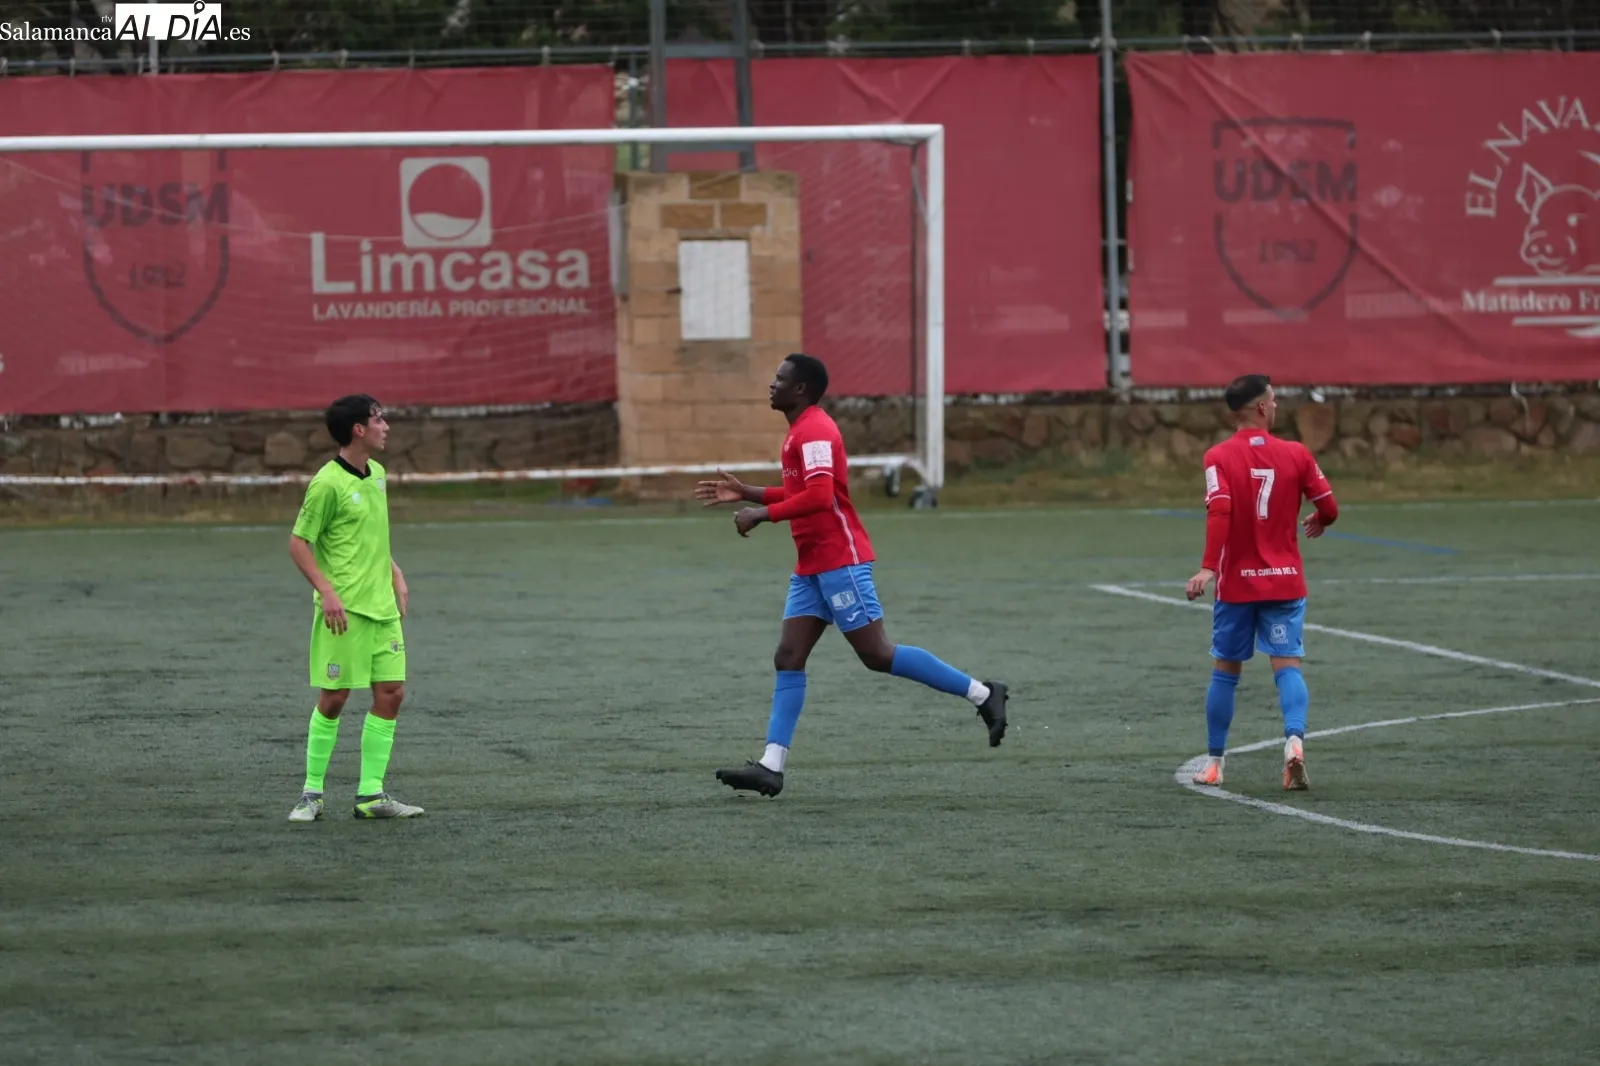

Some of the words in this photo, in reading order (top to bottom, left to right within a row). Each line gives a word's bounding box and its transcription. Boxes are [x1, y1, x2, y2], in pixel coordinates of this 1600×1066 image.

[1482, 94, 1600, 165] NAVA
[82, 182, 229, 228] UDSM
[1465, 163, 1503, 218] EL
[310, 231, 591, 294] Limcasa
[312, 297, 444, 321] LAVANDERÍA
[448, 296, 590, 319] PROFESIONAL
[1461, 288, 1573, 313] Matadero
[1251, 468, 1276, 520] 7
